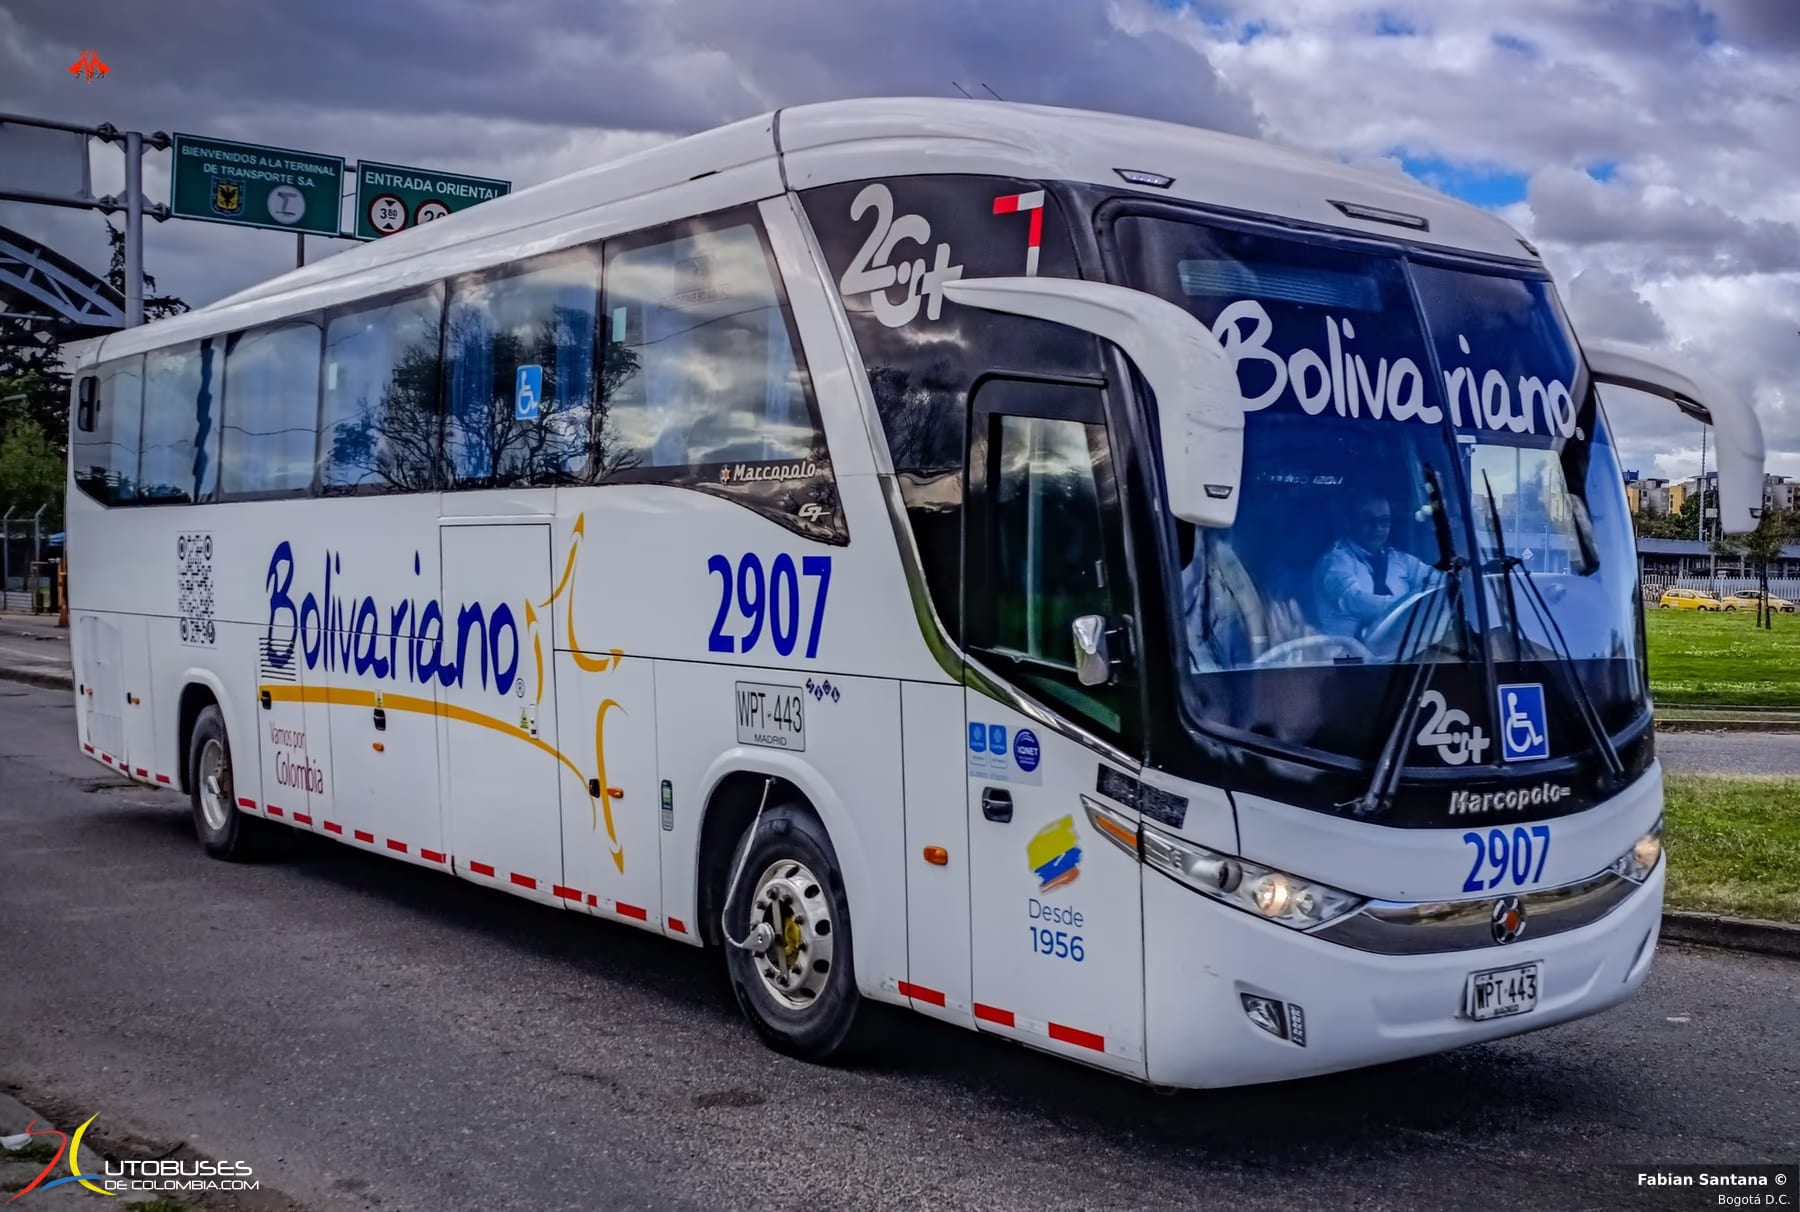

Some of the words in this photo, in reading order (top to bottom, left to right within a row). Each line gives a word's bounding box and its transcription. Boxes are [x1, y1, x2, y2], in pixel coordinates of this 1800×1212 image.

[182, 145, 256, 165] BIENVENIDOS
[259, 157, 267, 166] A
[268, 158, 283, 169] LA
[284, 160, 336, 176] TERMINAL
[203, 163, 218, 174] DE
[221, 165, 294, 184] TRANSPORTE
[365, 171, 433, 192] ENTRADA
[424, 210, 446, 222] 2
[733, 461, 816, 481] Marcopolo
[265, 540, 519, 695] Bolivariano
[707, 552, 832, 659] 2907
[269, 720, 292, 748] Vamos
[754, 733, 787, 746] MADRID
[276, 750, 324, 795] Colombia
[1449, 781, 1561, 816] Marcopolo
[1462, 825, 1550, 892] 2907
[1029, 898, 1084, 928] Desde
[1029, 926, 1085, 962] 1956
